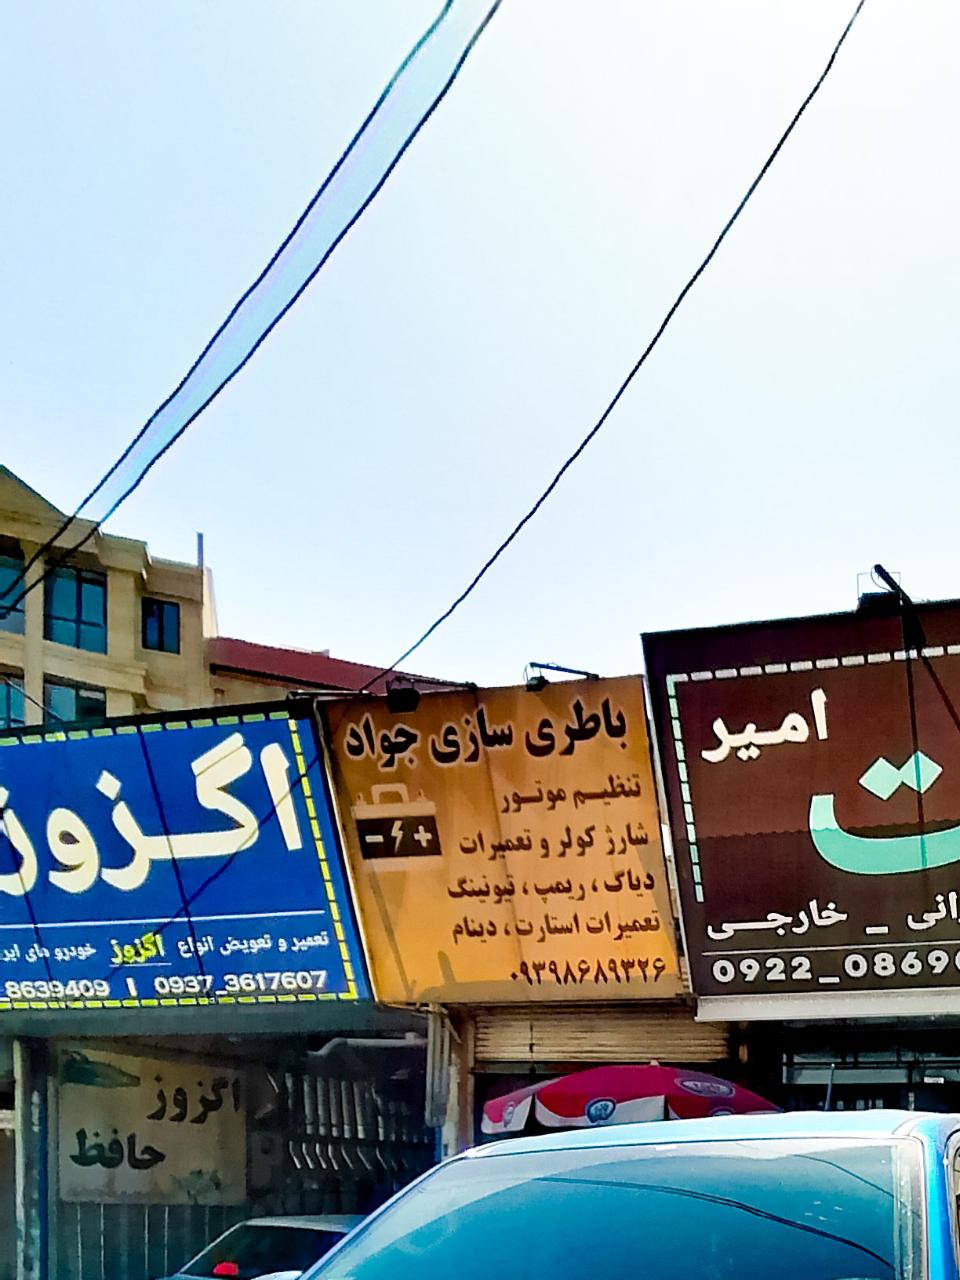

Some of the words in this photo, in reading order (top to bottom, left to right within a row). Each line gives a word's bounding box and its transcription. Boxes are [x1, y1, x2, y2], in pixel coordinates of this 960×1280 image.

[430, 705, 513, 764] سازی
[525, 698, 627, 757] باطری
[702, 688, 829, 763] امیر
[347, 713, 418, 769] جواد
[501, 781, 567, 813] موتور
[573, 774, 641, 808] تنظیم
[0, 732, 303, 896] اگزوز
[459, 829, 532, 860] تعمیرات
[540, 838, 550, 858] و
[558, 825, 596, 857] کولر
[607, 823, 648, 855] شارژ
[447, 875, 515, 904] تیونینگ
[534, 879, 586, 903] ریمپ
[452, 916, 497, 944] دینام
[516, 913, 580, 942] استارت
[586, 910, 660, 940] تعمیرات
[707, 899, 848, 940] خارجی
[0, 943, 20, 962] ایر
[25, 943, 50, 962] های
[54, 943, 96, 962] خودرو
[110, 932, 165, 964] اگزوز
[177, 936, 214, 958] انواع
[219, 935, 272, 955] تعویض
[278, 939, 288, 952] و
[291, 931, 329, 952] تعمیر
[154, 970, 328, 996] 0937_3617607
[511, 957, 667, 985] ۰۹۳۹۸۶۸۹۳۲۶
[5, 979, 110, 998] 8639409
[147, 1074, 241, 1124] اگزوز
[69, 1128, 167, 1170] حافظ
